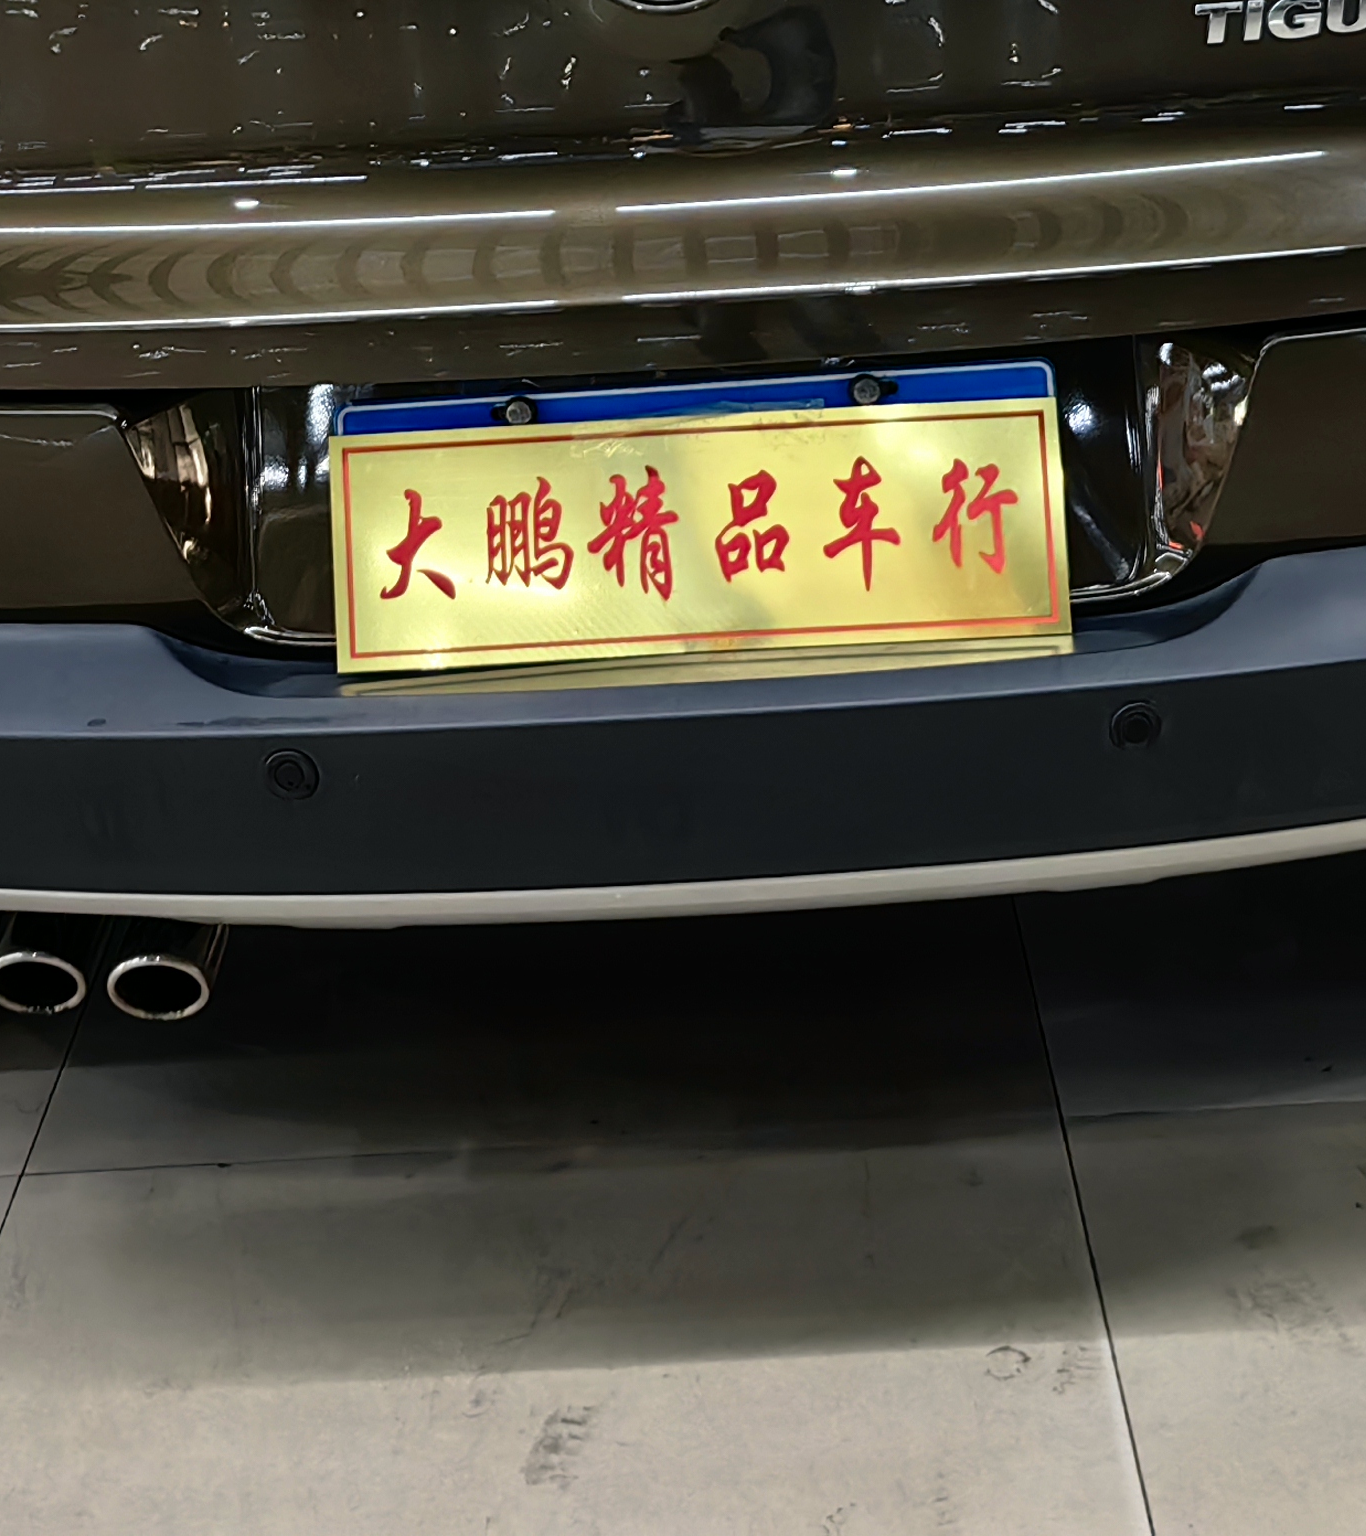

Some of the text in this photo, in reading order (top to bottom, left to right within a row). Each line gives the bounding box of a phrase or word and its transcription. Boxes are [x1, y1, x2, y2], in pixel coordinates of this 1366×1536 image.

[379, 455, 1019, 602] 大鹏精品车行
